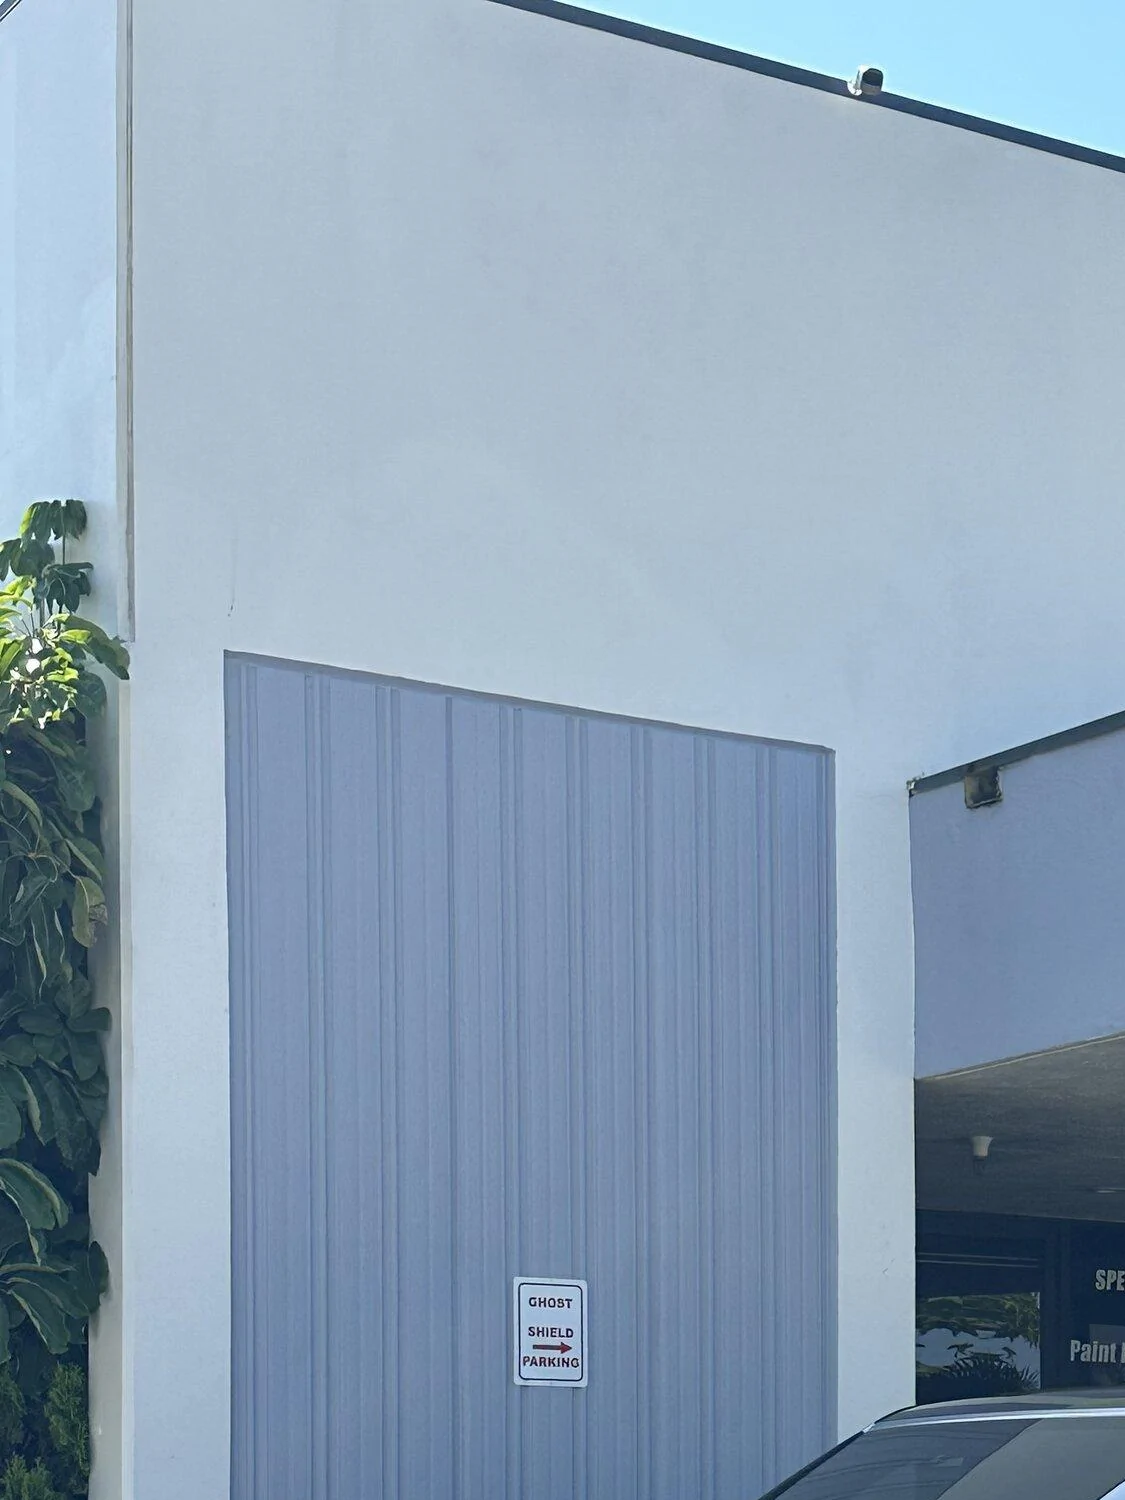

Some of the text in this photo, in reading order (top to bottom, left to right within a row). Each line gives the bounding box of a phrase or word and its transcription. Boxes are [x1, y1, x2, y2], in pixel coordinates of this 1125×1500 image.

[528, 1296, 573, 1309] GHOST
[528, 1326, 574, 1339] SHIELD
[1070, 1339, 1117, 1364] Paint
[522, 1355, 580, 1369] PARKING
